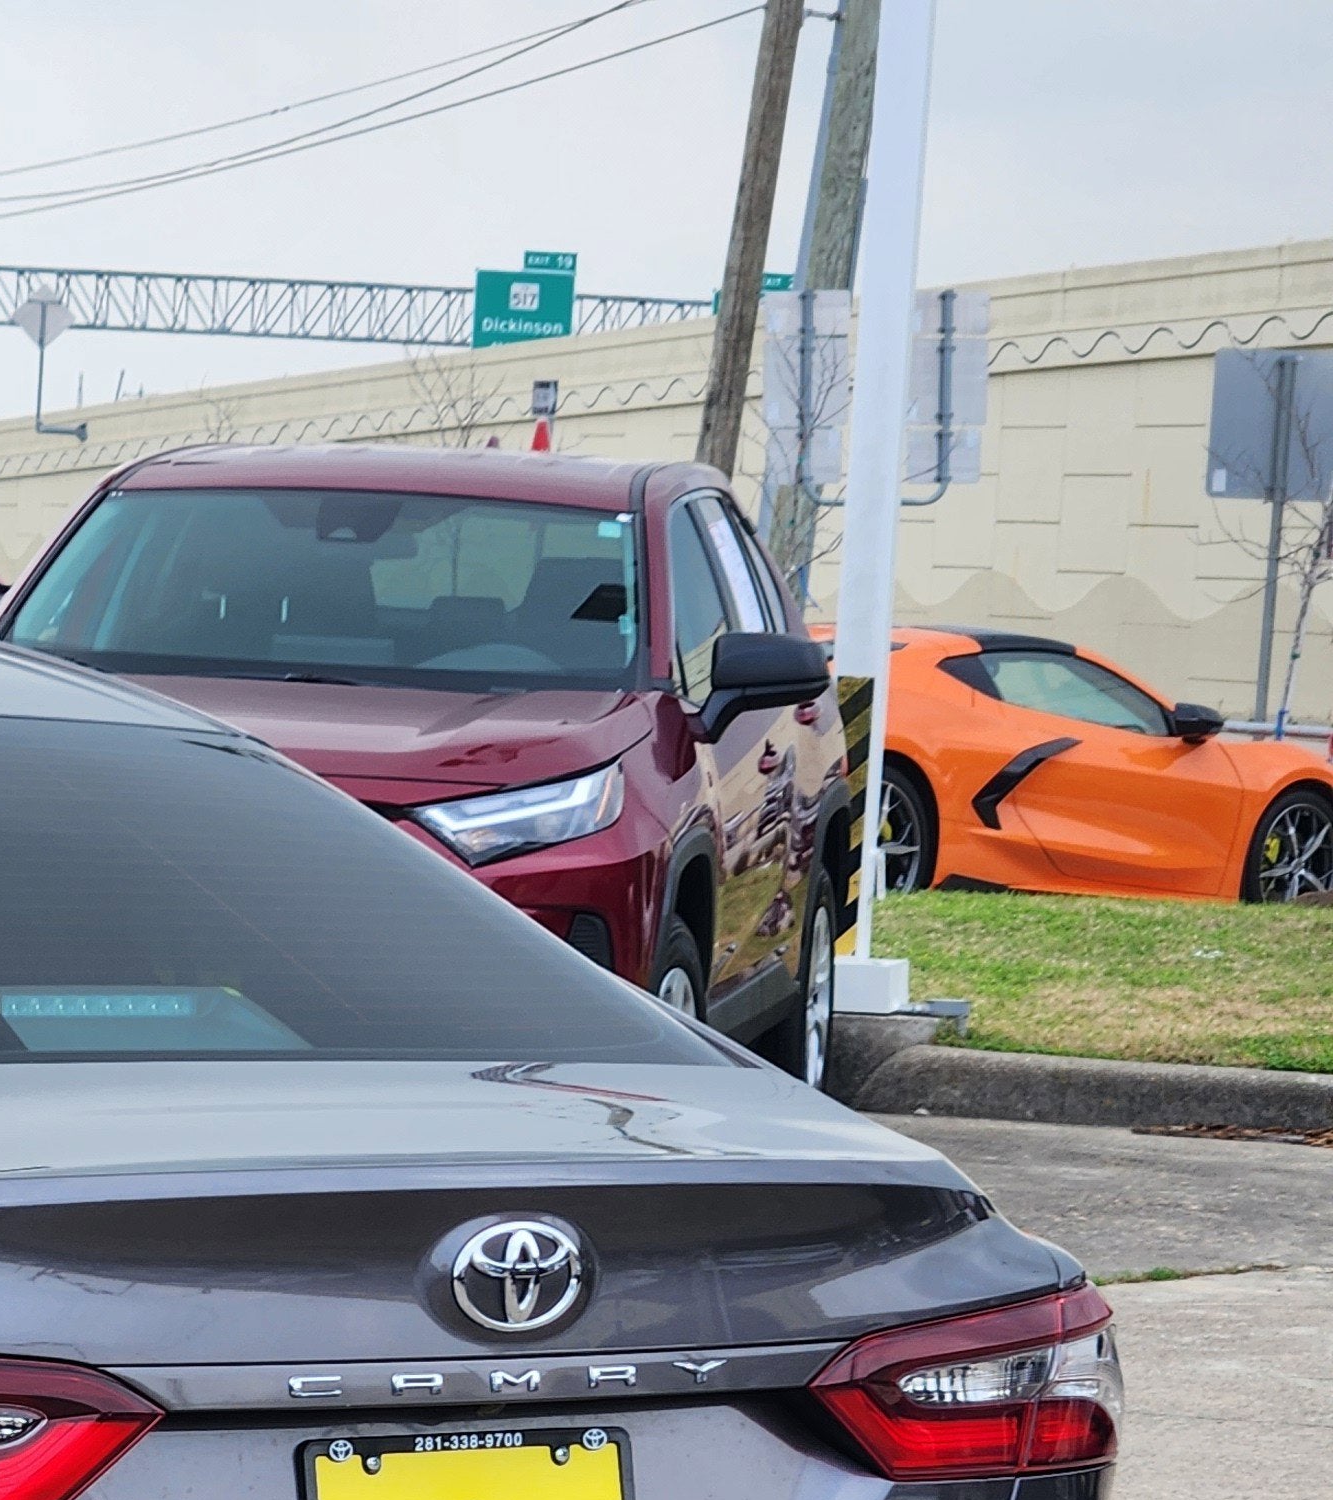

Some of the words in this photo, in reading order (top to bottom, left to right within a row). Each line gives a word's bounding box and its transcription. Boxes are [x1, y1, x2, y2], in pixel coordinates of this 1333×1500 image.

[527, 254, 550, 265] EXIT
[556, 255, 573, 269] 19
[512, 292, 537, 307] 517
[482, 316, 564, 335] Dickinson
[288, 1358, 728, 1399] CAMRY
[413, 1432, 524, 1451] 281-338-9700
